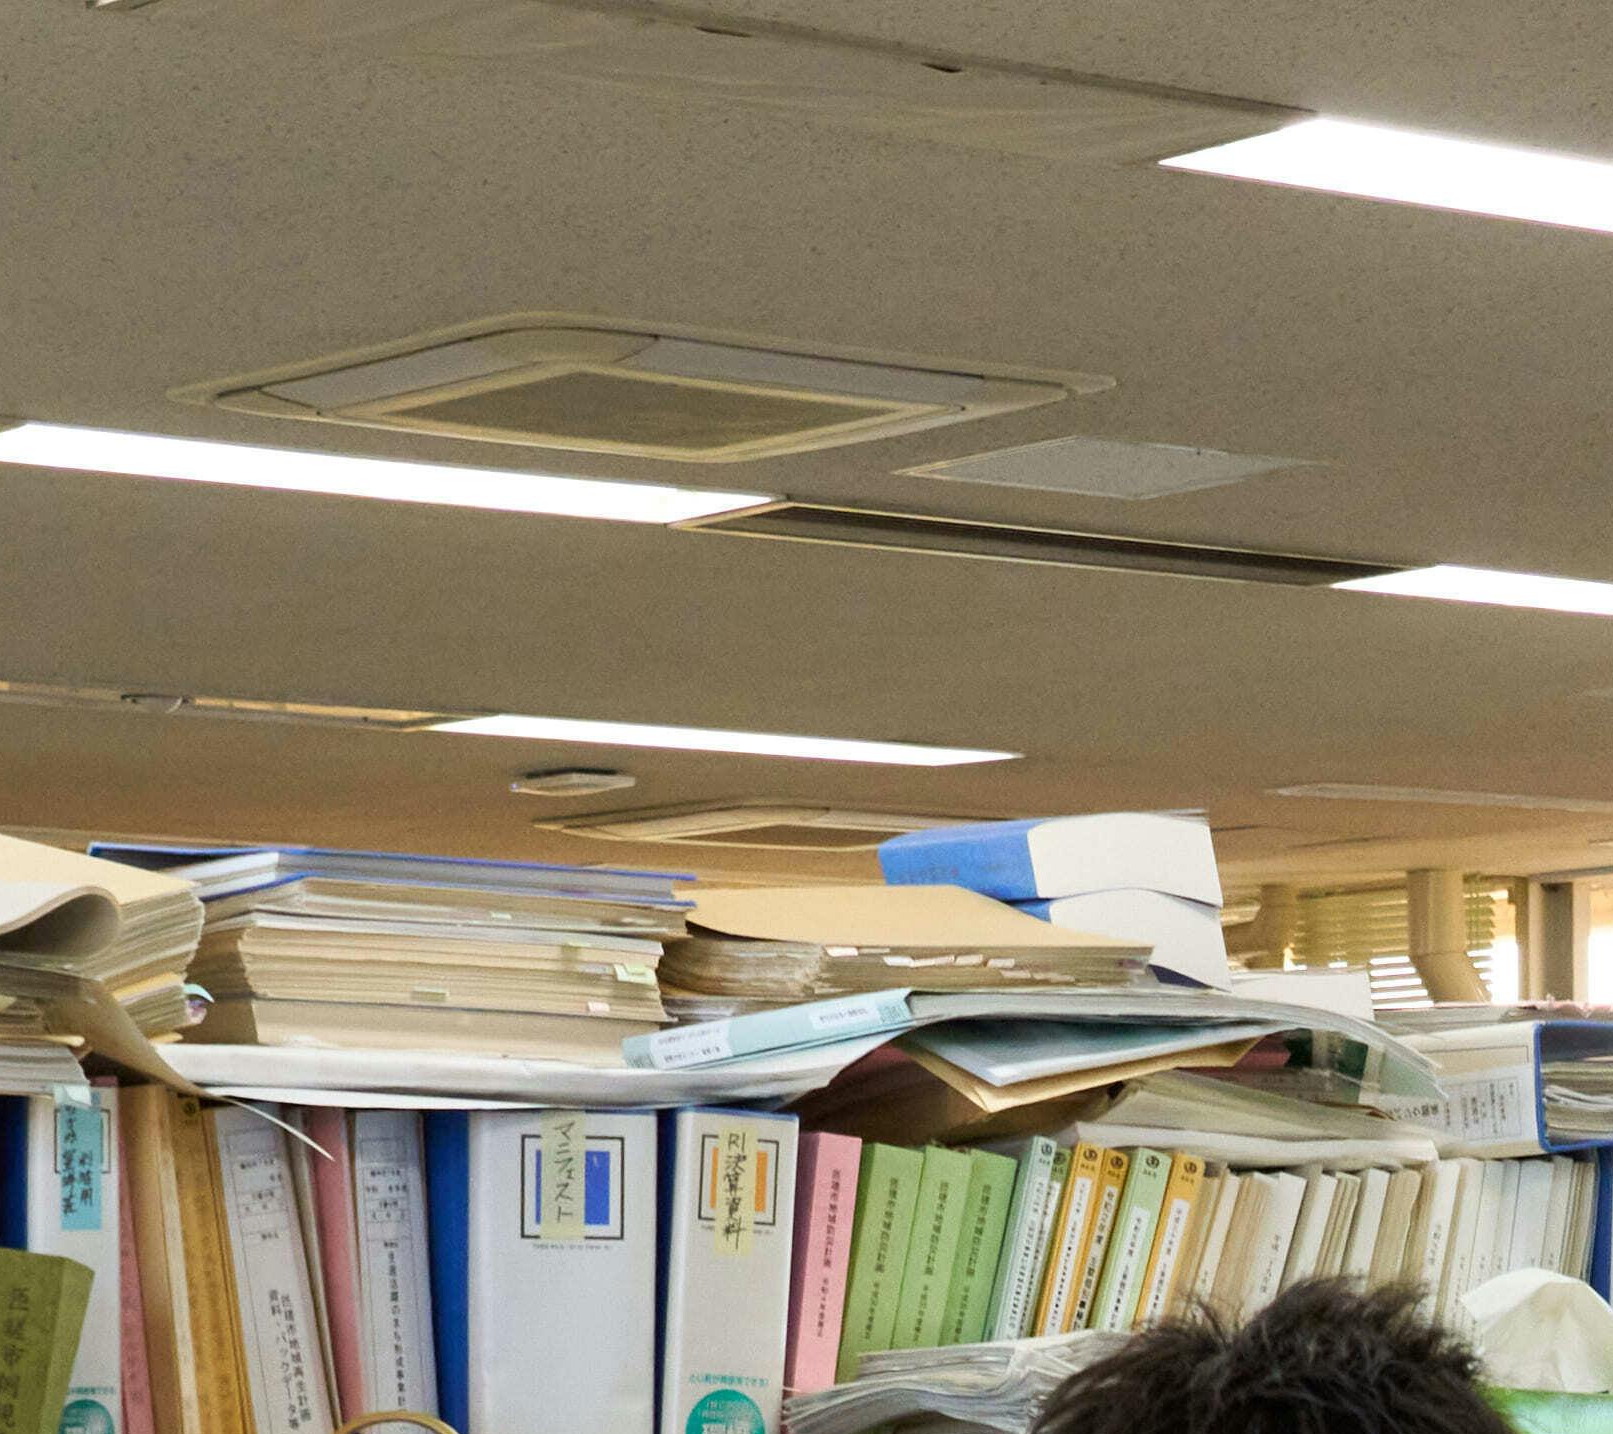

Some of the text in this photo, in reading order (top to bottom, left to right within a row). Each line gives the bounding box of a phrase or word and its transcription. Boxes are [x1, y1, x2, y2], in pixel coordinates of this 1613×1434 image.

[553, 1119, 577, 1224] マニフェスト
